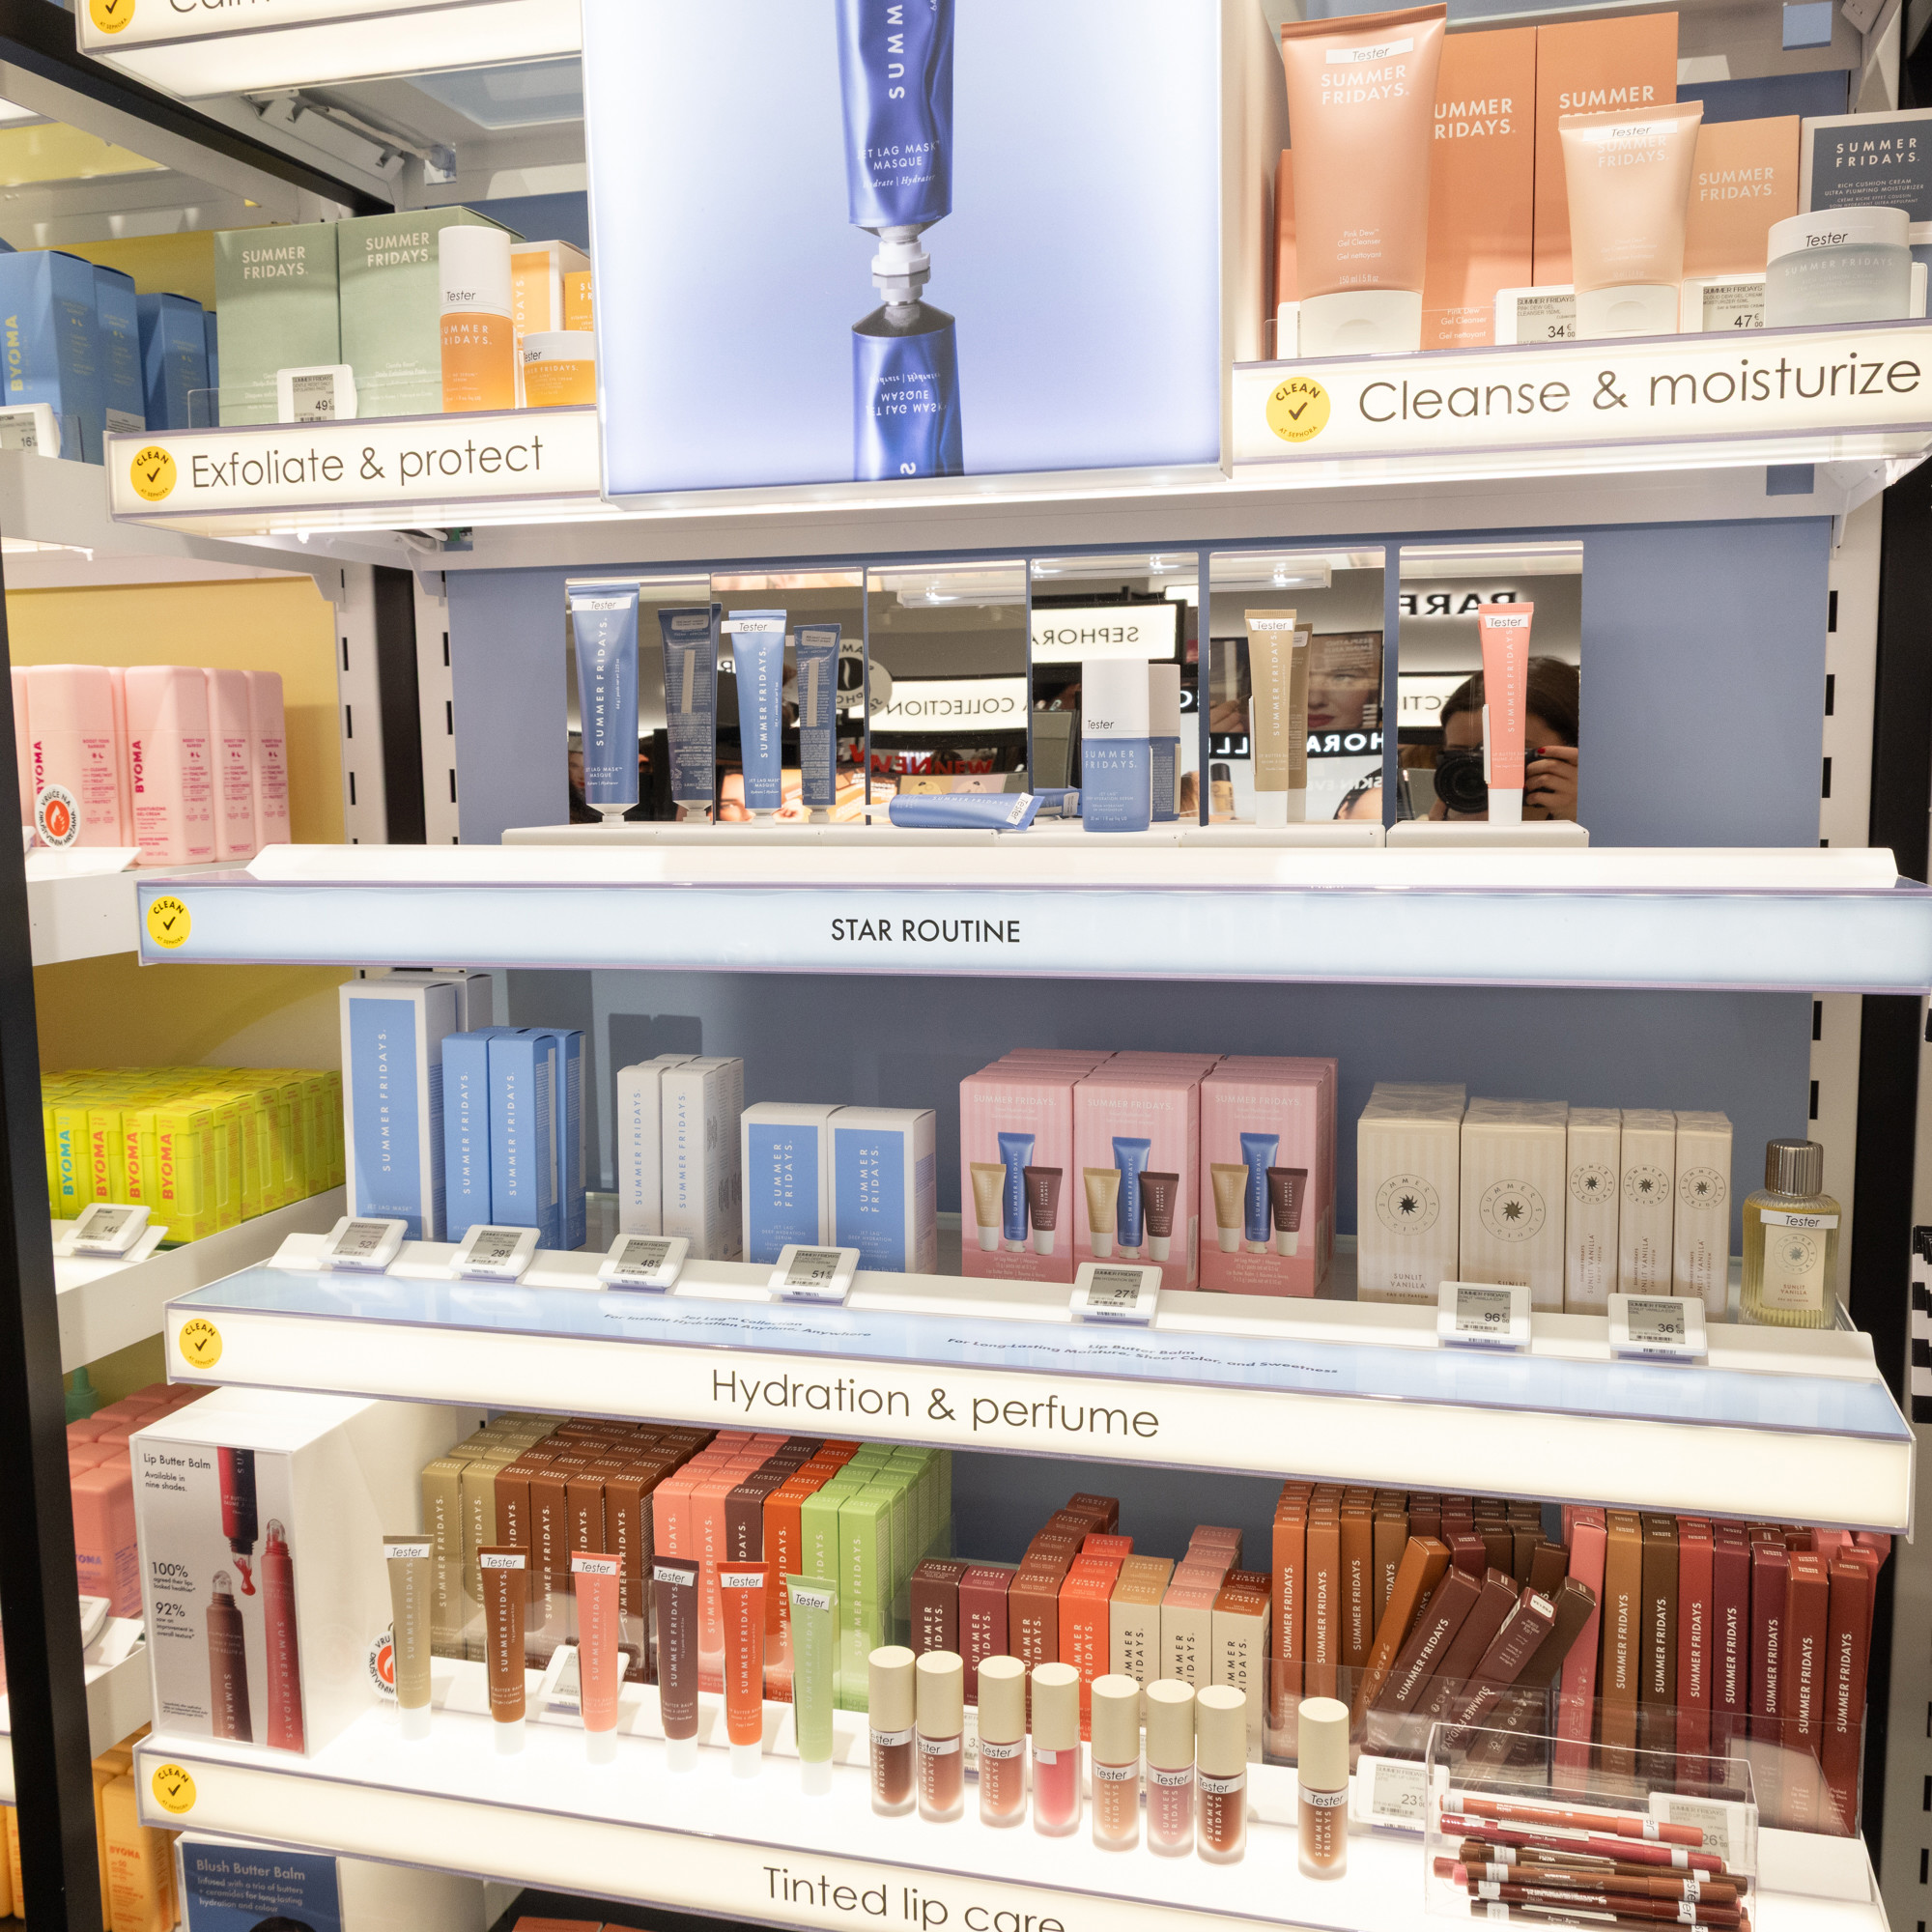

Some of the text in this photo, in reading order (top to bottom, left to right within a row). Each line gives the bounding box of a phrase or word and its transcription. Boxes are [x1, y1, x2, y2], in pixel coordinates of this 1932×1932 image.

[1352, 46, 1390, 62] Tester
[1321, 64, 1406, 87] SUMMER
[1560, 85, 1654, 109] SUMMER
[1611, 125, 1651, 138] Tester
[878, 146, 899, 158] LAG
[1836, 138, 1918, 154] SUMMER
[874, 156, 922, 170] MASQUE
[1698, 167, 1774, 185] SUMMER
[366, 232, 430, 251] SUMMER
[1337, 237, 1381, 247] Gel Cleanser
[1805, 231, 1848, 247] Tester
[242, 246, 306, 264] SUMMER
[1336, 251, 1382, 261] Gel nettoyant
[446, 290, 476, 302] Tester
[8, 314, 24, 392] BYOMA
[1276, 383, 1321, 401] CLEAN
[1359, 352, 1921, 422] Cleanse & moisturize
[1287, 426, 1318, 438] SEPHORA
[136, 451, 169, 467] CLEAN
[192, 435, 544, 488] Exfoliate & protect
[591, 600, 617, 611] Tester
[739, 622, 767, 632] Tester
[1256, 621, 1288, 631] Tester
[1490, 617, 1523, 628] Tester
[596, 693, 604, 746] SUMMER
[1087, 719, 1115, 730] Tester
[1085, 750, 1135, 758] SUMMER
[132, 741, 144, 793] BYOMA
[154, 901, 184, 914] CLEAN
[831, 918, 1020, 943] STAR ROUTINE
[974, 1094, 1014, 1105] SUMMER
[381, 1106, 391, 1172] SUMMER
[59, 1130, 74, 1195] BYOMA
[93, 1130, 107, 1197] BYOMA
[160, 1134, 174, 1200] BYOMA
[508, 1138, 517, 1196] SUMMER
[773, 1143, 782, 1207] SUMMER
[1786, 1215, 1819, 1227] Tester
[185, 1323, 215, 1336] CLEAN
[803, 1328, 871, 1337] Anywhere
[713, 1369, 1160, 1439] Hydration & perfume
[144, 1453, 211, 1469] Lip Butter Balm
[145, 1471, 177, 1481] Available
[162, 1482, 188, 1492] shades.
[392, 1547, 423, 1558] Tester
[152, 1562, 188, 1578] 100%
[486, 1557, 517, 1568] Tester
[657, 1568, 686, 1584] Tester
[728, 1576, 761, 1588] Tester
[795, 1593, 825, 1609] Tester
[156, 1602, 185, 1618] 92%
[779, 1591, 787, 1647] SUMMER
[1284, 1613, 1292, 1659] SUMMER
[277, 1621, 288, 1678] SUMMER
[500, 1626, 509, 1674] SUMMER
[1655, 1645, 1666, 1693] SUMMER
[1397, 1655, 1428, 1701] SUMMER
[1726, 1655, 1736, 1704] SUMMER
[1837, 1683, 1849, 1733] SUMMER
[158, 1768, 189, 1783] CLEAN
[1095, 1767, 1127, 1780] Tester
[1199, 1778, 1229, 1793] Tester
[1310, 1794, 1344, 1806] Tester
[196, 1859, 305, 1881] Blush Butter Balm
[277, 1886, 303, 1894] butters
[763, 1866, 1066, 1932] Tinted lip care
